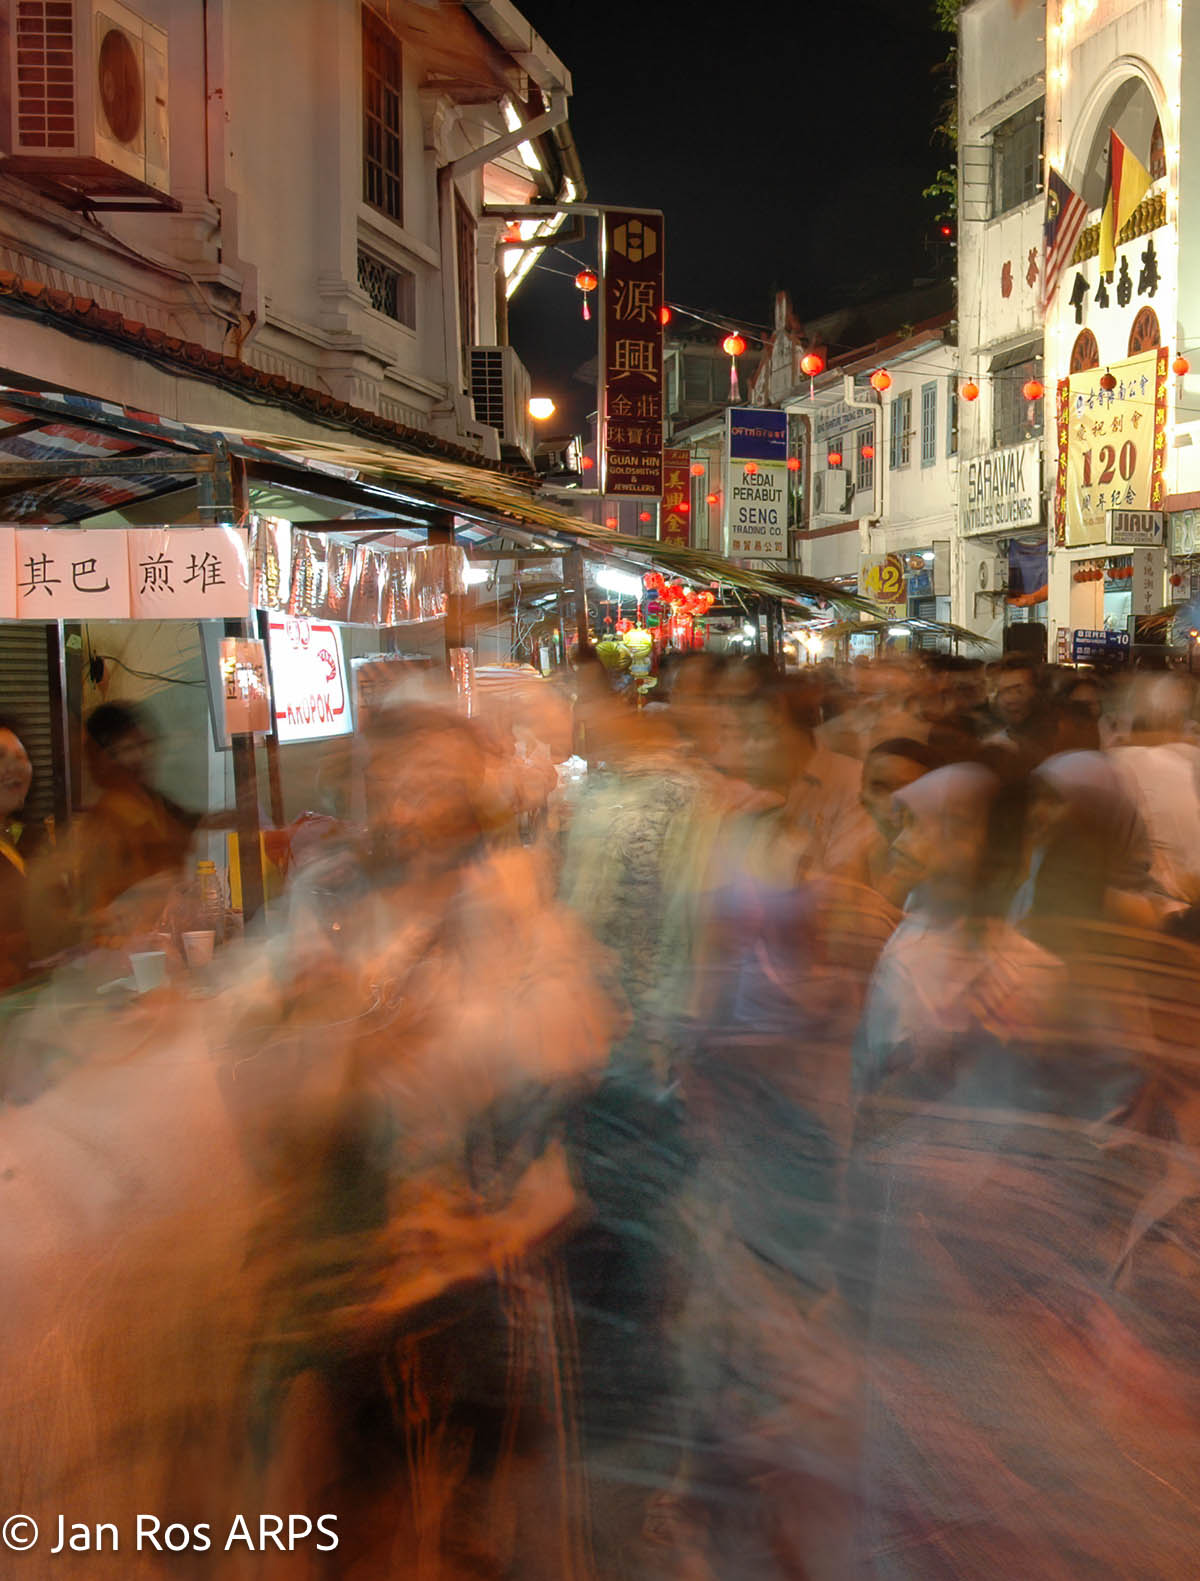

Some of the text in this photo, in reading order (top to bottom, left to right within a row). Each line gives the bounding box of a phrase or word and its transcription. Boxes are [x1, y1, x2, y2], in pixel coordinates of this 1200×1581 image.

[609, 454, 639, 466] GUAN
[641, 456, 660, 467] HIN
[1081, 440, 1137, 488] 120
[609, 466, 660, 476] GOLDSMITHS
[742, 471, 774, 487] KEDAI
[968, 448, 1025, 506] SARAWAK
[613, 483, 656, 493] JEWELLERS
[733, 487, 782, 503] PERABUT
[739, 507, 777, 525] SENG
[733, 524, 784, 537] TRADING CO.
[17, 551, 227, 598] 其巴 煎堆
[865, 565, 900, 593] 42
